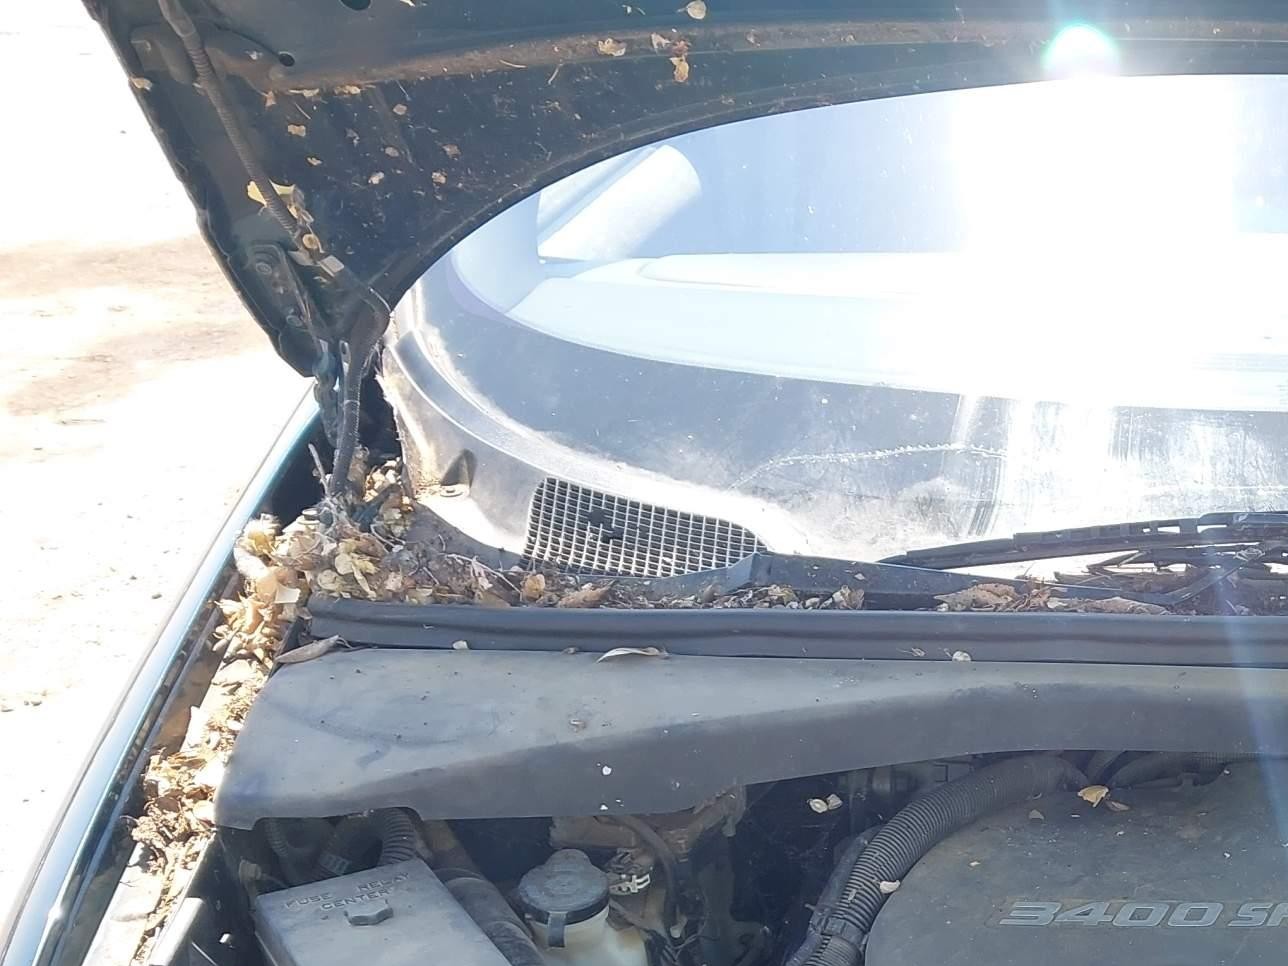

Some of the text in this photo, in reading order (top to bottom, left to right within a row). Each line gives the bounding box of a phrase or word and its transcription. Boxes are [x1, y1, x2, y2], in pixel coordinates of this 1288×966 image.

[284, 873, 410, 909] FUSE RELAY
[320, 889, 390, 910] CENTER
[999, 901, 1224, 928] 3400
